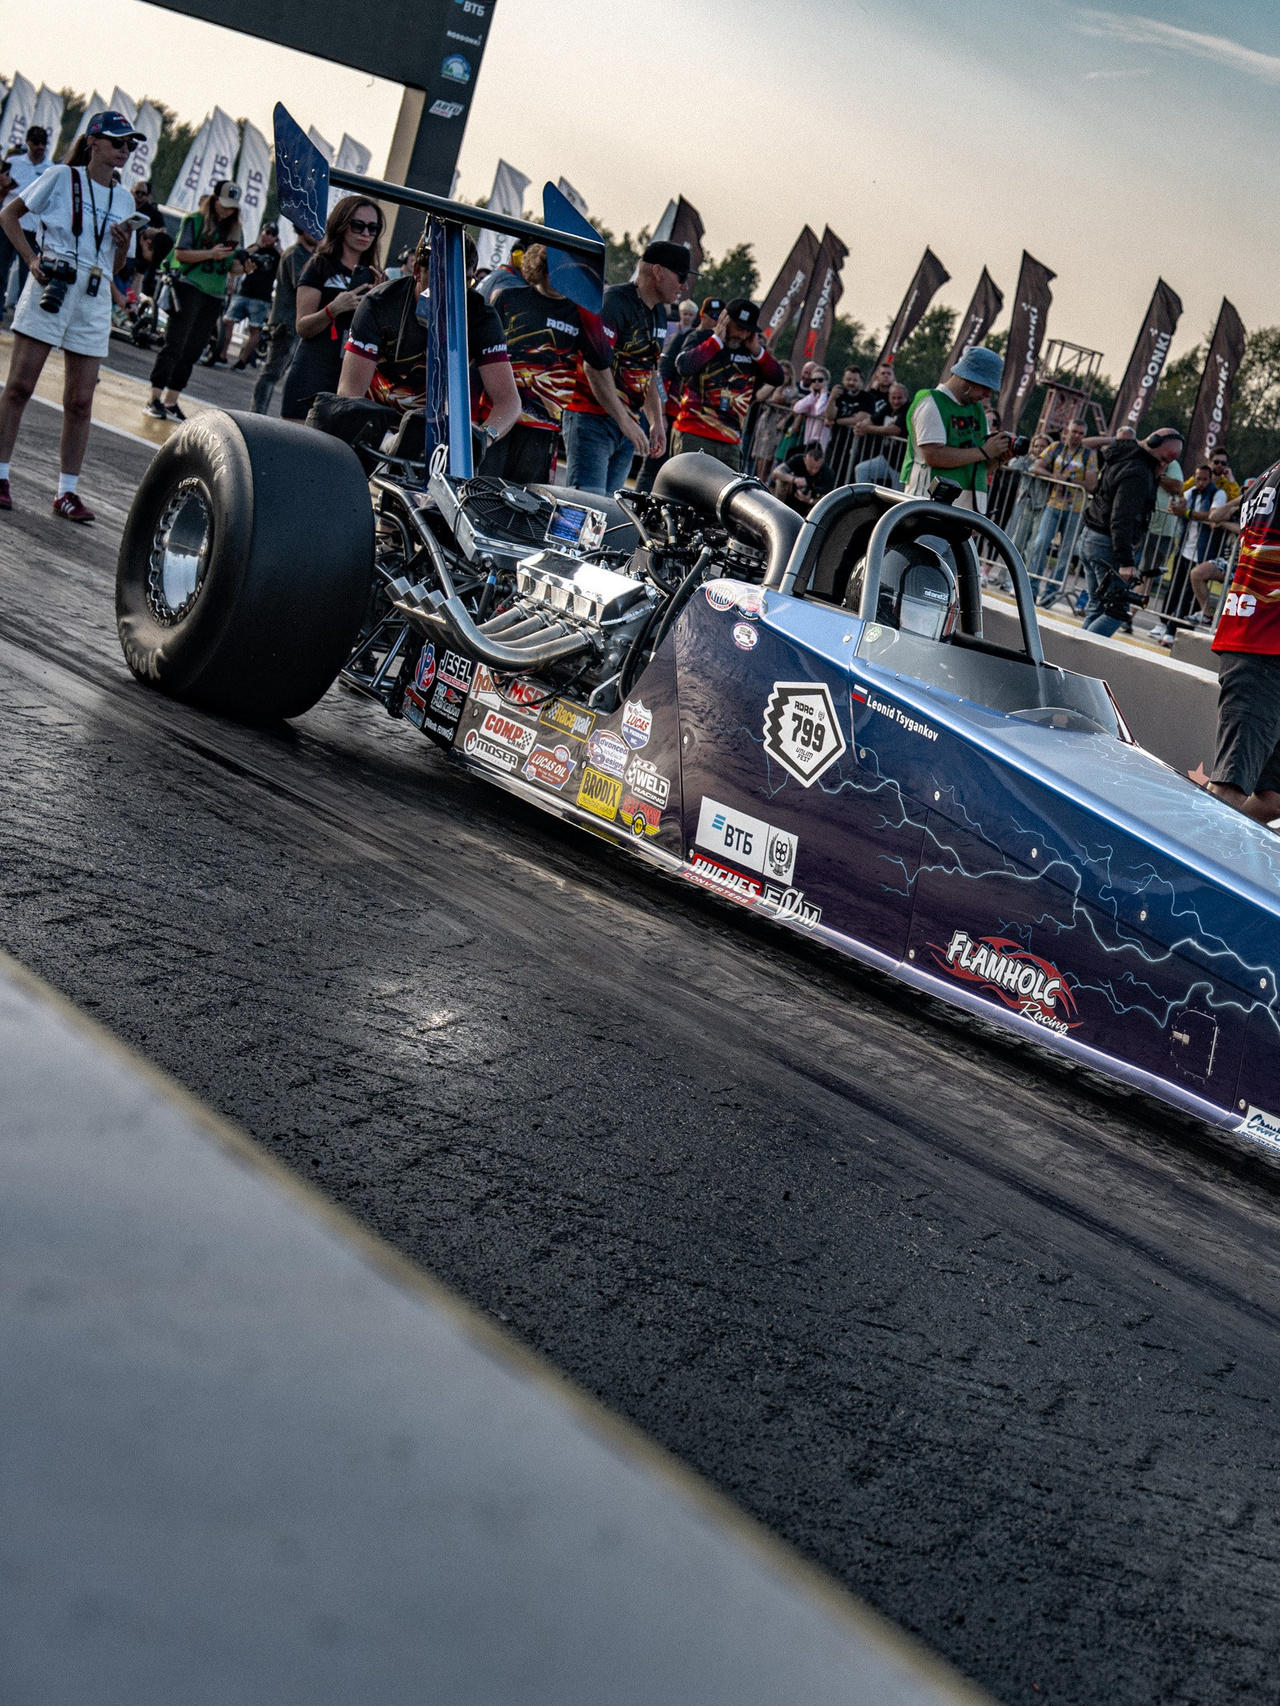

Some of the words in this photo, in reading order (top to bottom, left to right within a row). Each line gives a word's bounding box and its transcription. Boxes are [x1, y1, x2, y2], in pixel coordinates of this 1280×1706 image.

[463, 1, 485, 17] ВТБ
[8, 113, 27, 147] ВТБ
[131, 142, 151, 178] ВТБ
[245, 168, 263, 208] ВТБ
[1127, 331, 1171, 423] ROSGONKI
[438, 650, 472, 682] JESEL
[554, 704, 591, 735] Racepak
[626, 714, 650, 732] LUCAS
[794, 700, 814, 716] RDRC
[866, 695, 895, 719] Leonid
[895, 709, 939, 742] Tsygankov
[484, 714, 524, 741] COMP
[507, 737, 527, 751] CAMS
[791, 712, 826, 753] 799
[531, 753, 554, 773] LUCAS
[553, 762, 568, 778] OIL
[796, 753, 811, 764] FEST
[581, 771, 620, 808] BRODIX
[633, 786, 667, 806] RACING
[636, 766, 669, 798] WELD
[724, 823, 754, 856] ВТБ
[683, 871, 750, 904] CONVERTERS
[689, 858, 761, 899] HUGHES
[946, 930, 1061, 1008] FLAMHOLC
[1019, 1000, 1070, 1038] Racing
